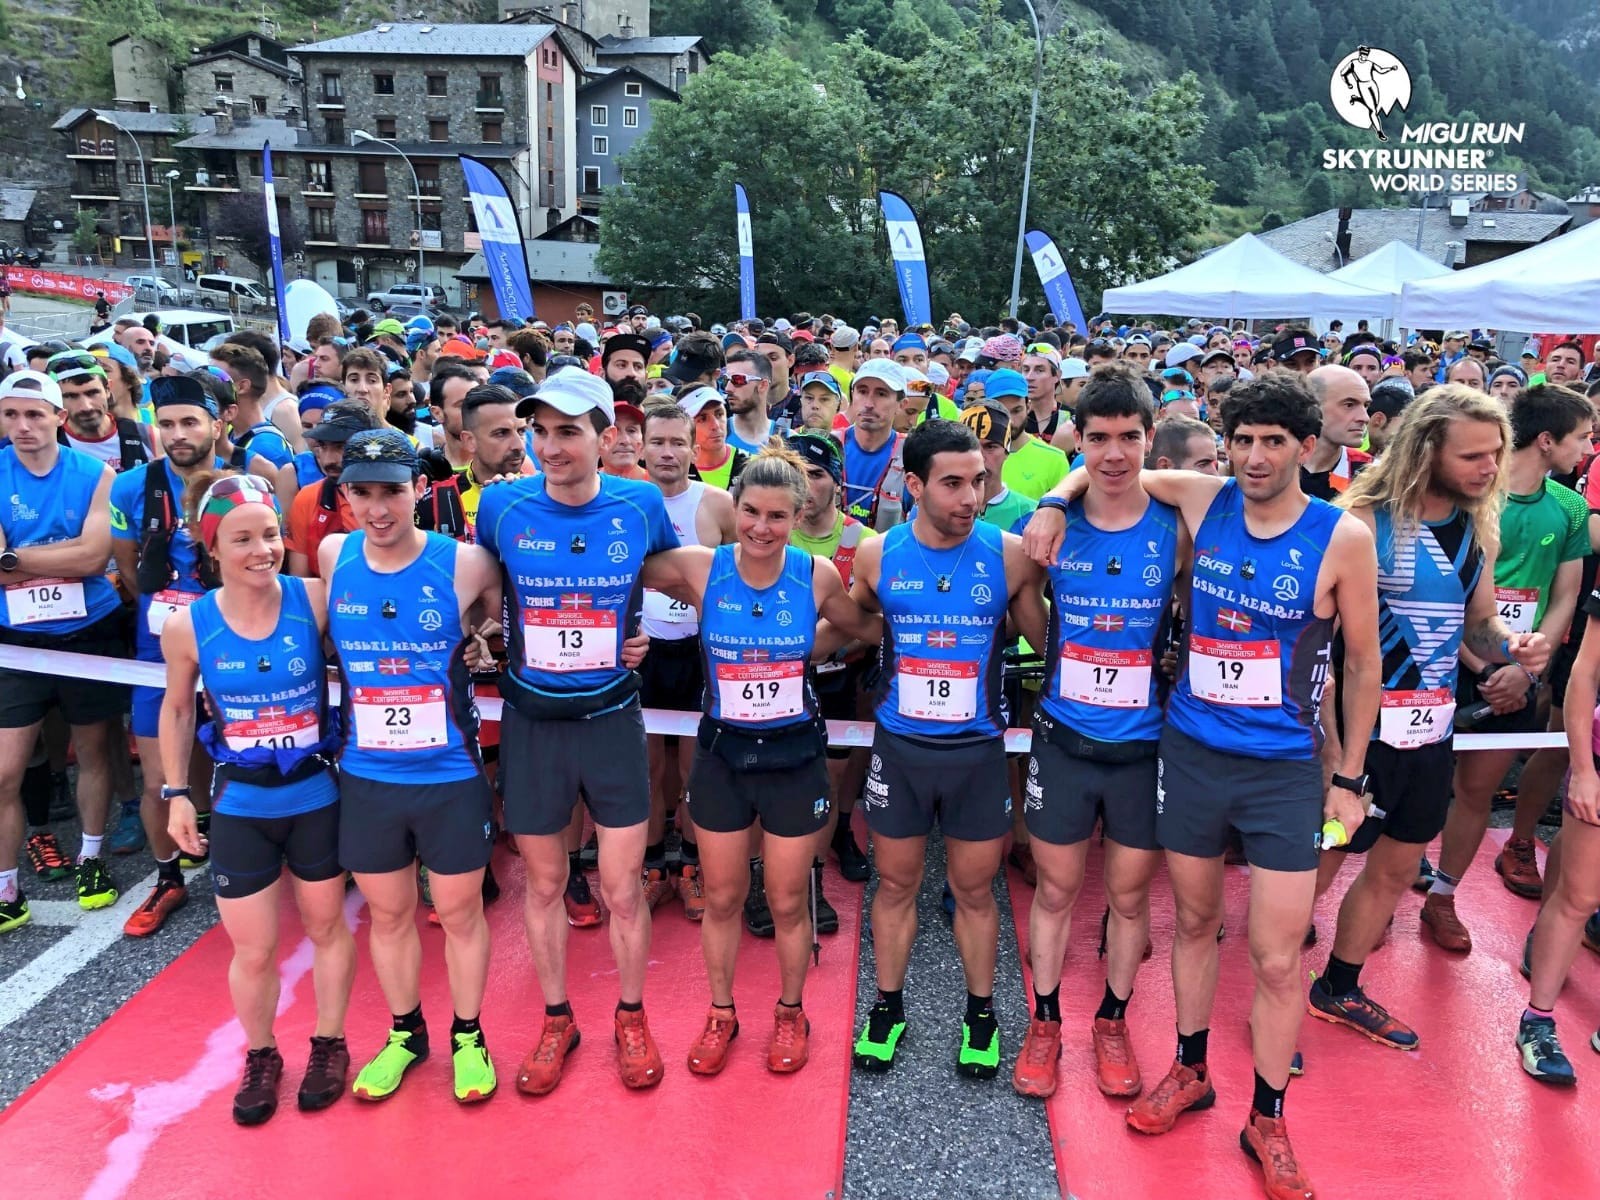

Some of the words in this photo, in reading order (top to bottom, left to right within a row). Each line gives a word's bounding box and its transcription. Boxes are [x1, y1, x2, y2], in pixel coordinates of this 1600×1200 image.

[518, 539, 556, 551] EKFB
[1060, 561, 1094, 572] EKFB
[1198, 555, 1235, 576] EKFB
[891, 580, 924, 591] EKFB
[28, 586, 62, 604] 106
[336, 603, 369, 615] EKFB
[717, 601, 743, 611] EKFB
[1238, 593, 1305, 620] HERRIA
[557, 629, 584, 650] 13
[216, 661, 246, 670] EKFB
[1217, 660, 1244, 681] 19
[1092, 666, 1120, 686] 17
[742, 681, 780, 700] 619
[926, 679, 951, 698] 18
[384, 707, 412, 726] 23
[1410, 708, 1434, 726] 24
